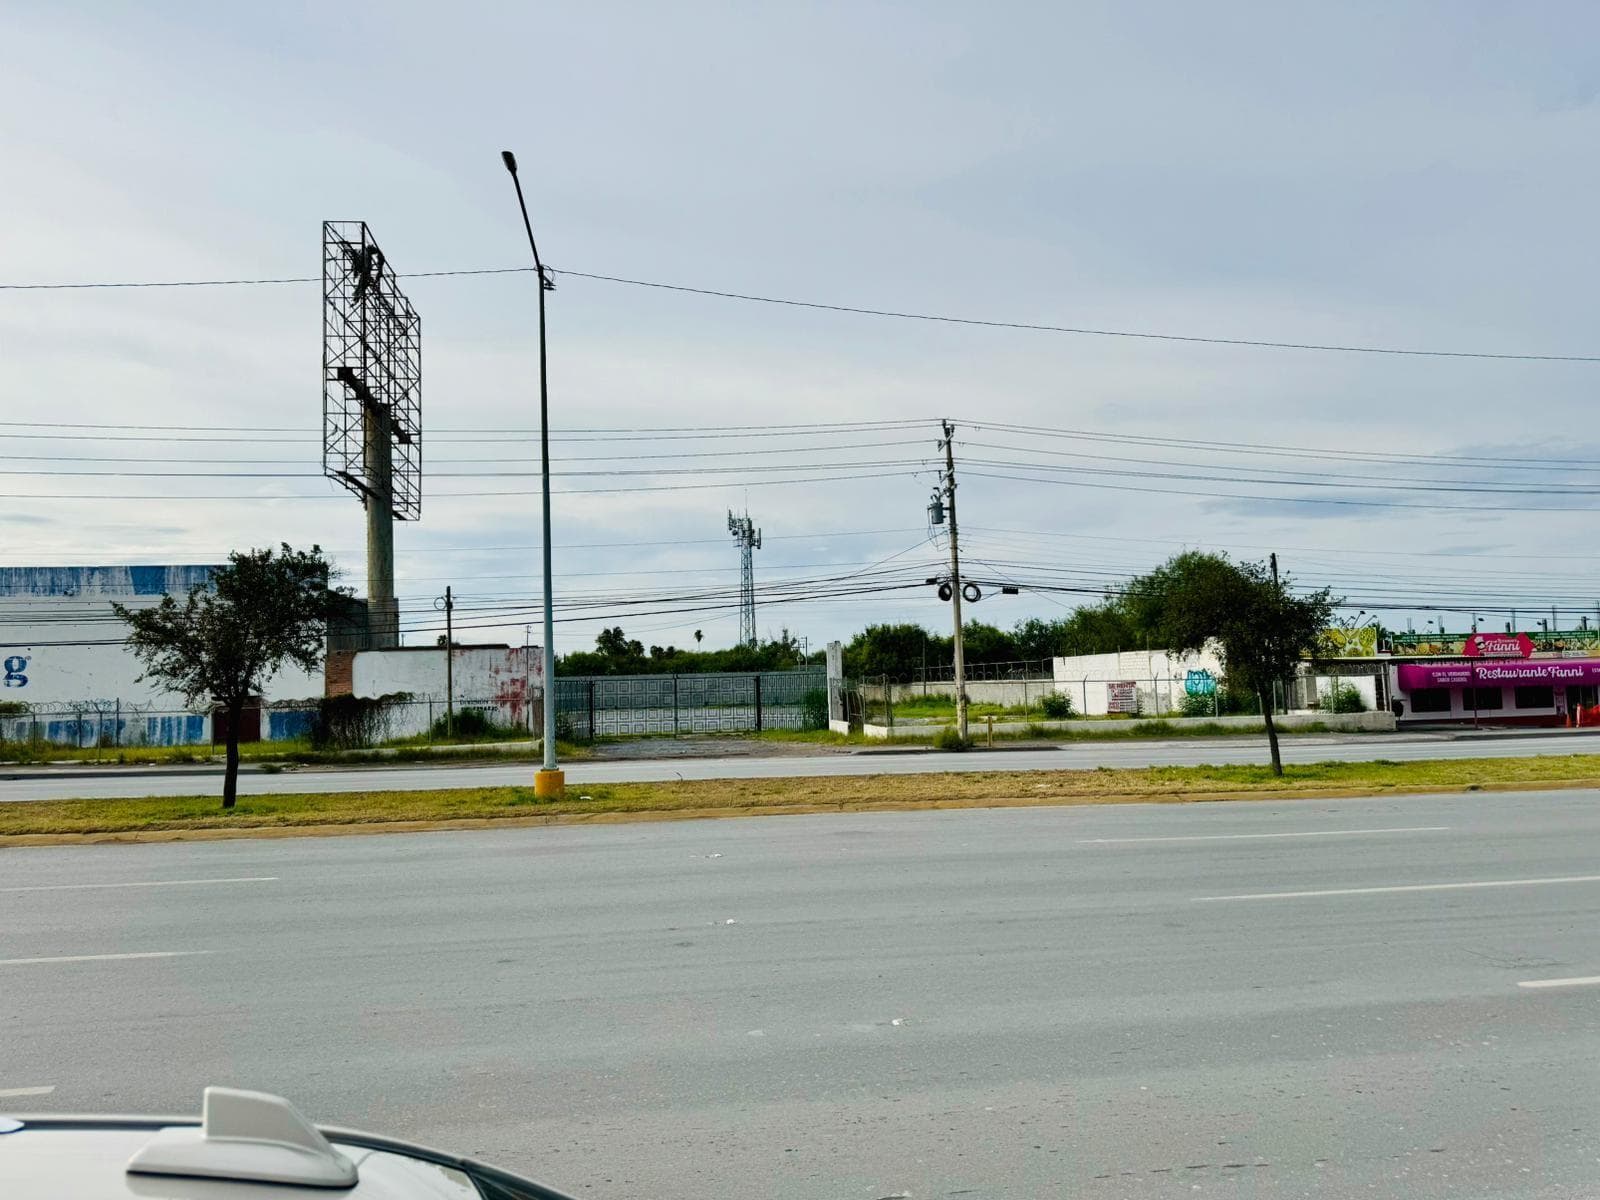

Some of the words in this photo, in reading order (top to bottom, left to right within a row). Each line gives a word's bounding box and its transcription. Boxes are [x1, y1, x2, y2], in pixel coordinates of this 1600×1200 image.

[1485, 640, 1520, 651] Fanni
[1476, 666, 1548, 679] Restaurante
[1548, 665, 1584, 678] Fanni
